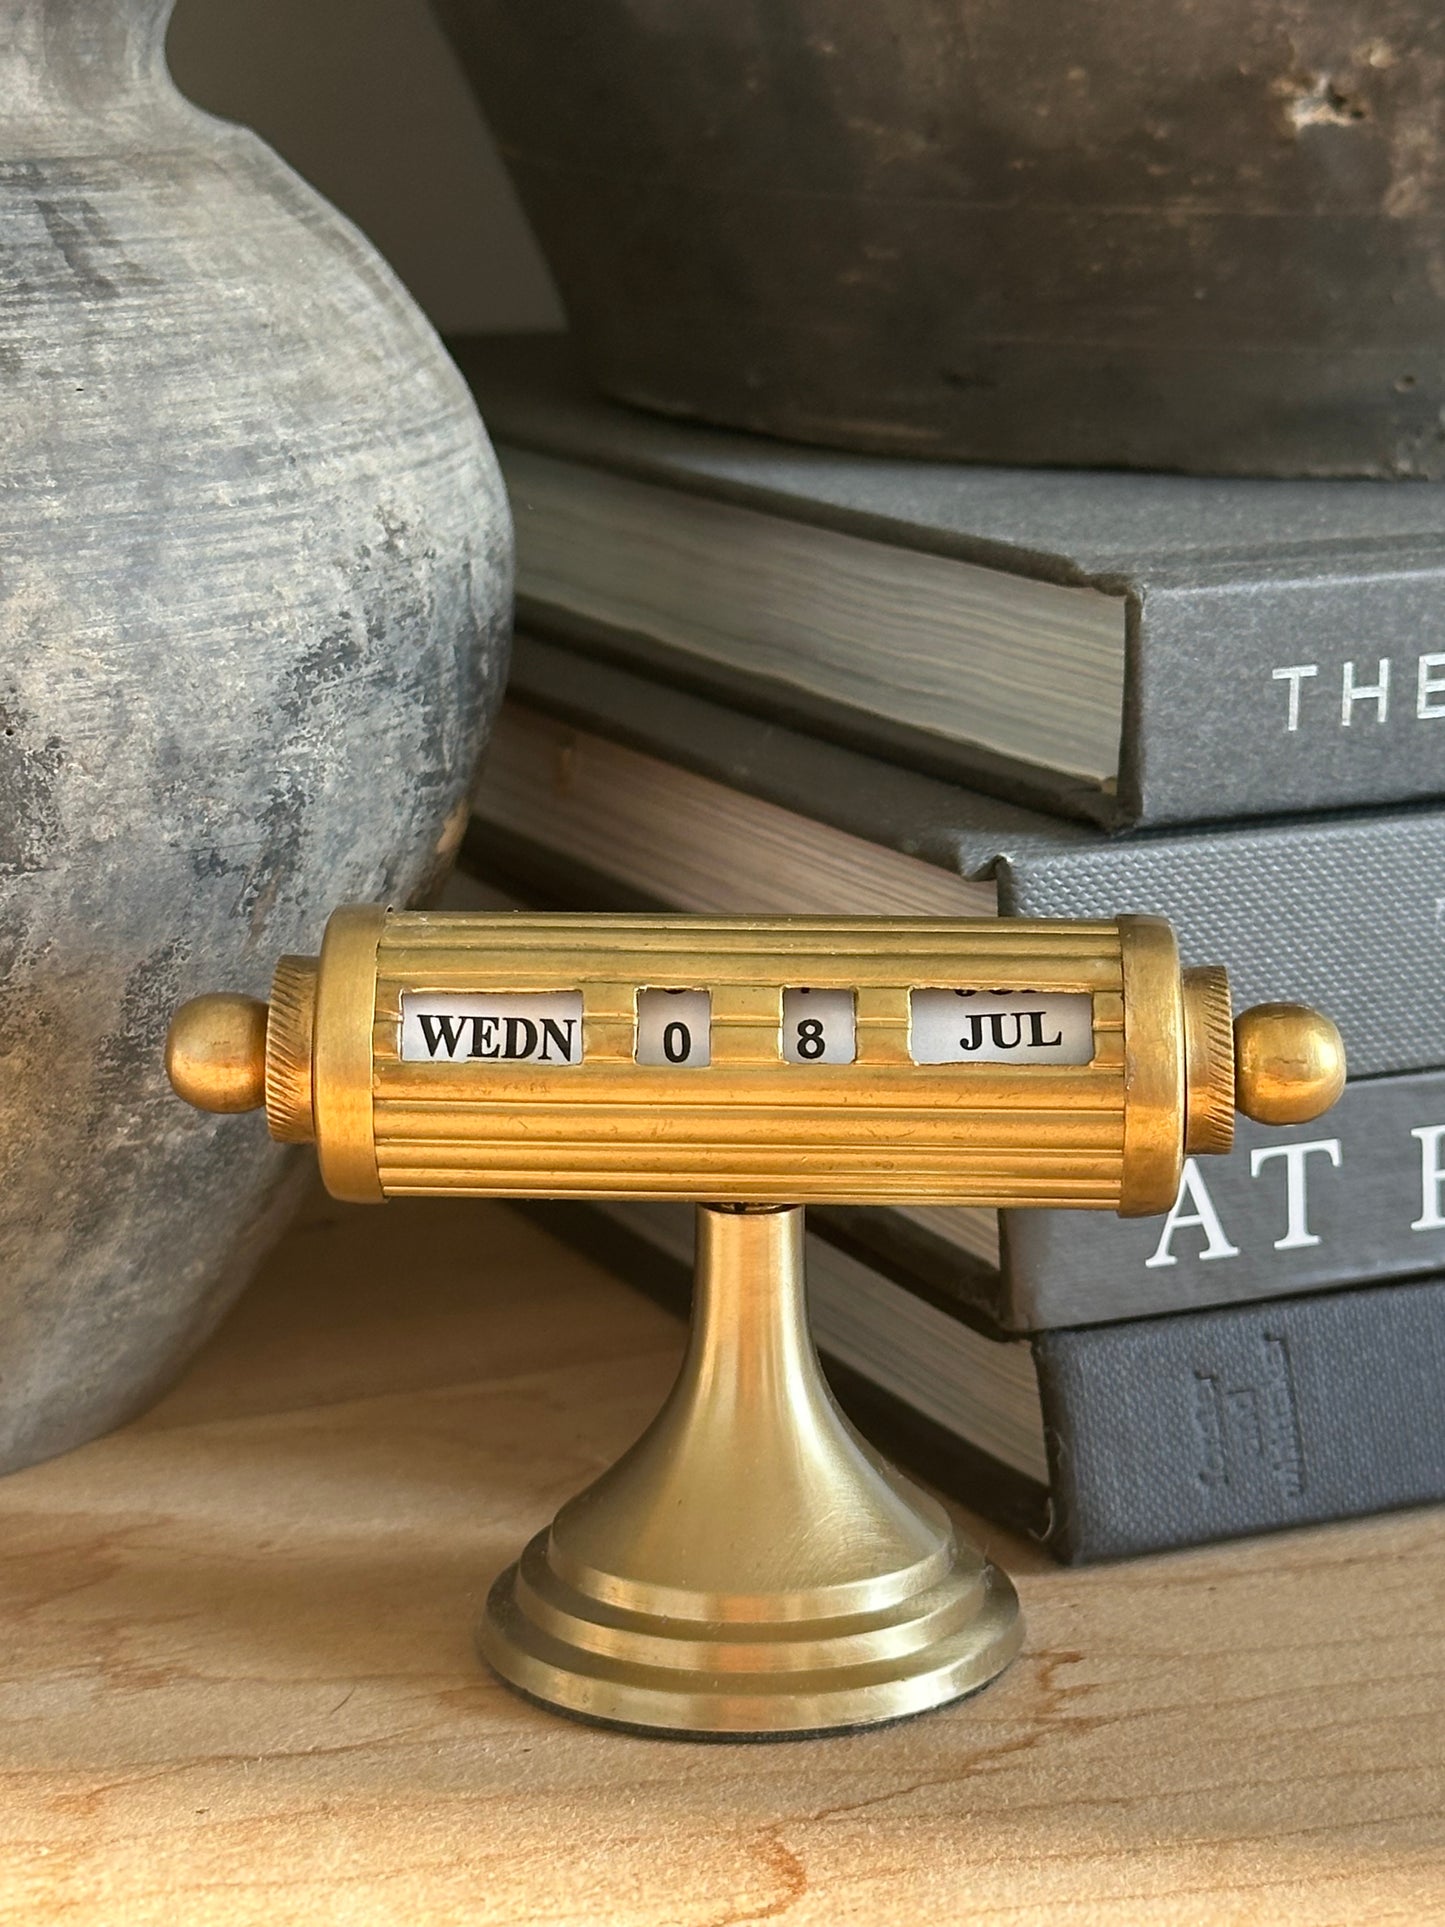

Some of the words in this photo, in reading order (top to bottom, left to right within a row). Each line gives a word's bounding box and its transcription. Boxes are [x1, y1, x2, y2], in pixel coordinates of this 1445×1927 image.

[1272, 653, 1445, 731] THE
[416, 1014, 577, 1062] WEDN
[663, 1021, 691, 1063] 0
[797, 1019, 825, 1059] 8
[959, 1011, 1062, 1051] JUL
[1145, 1138, 1342, 1269] AT
